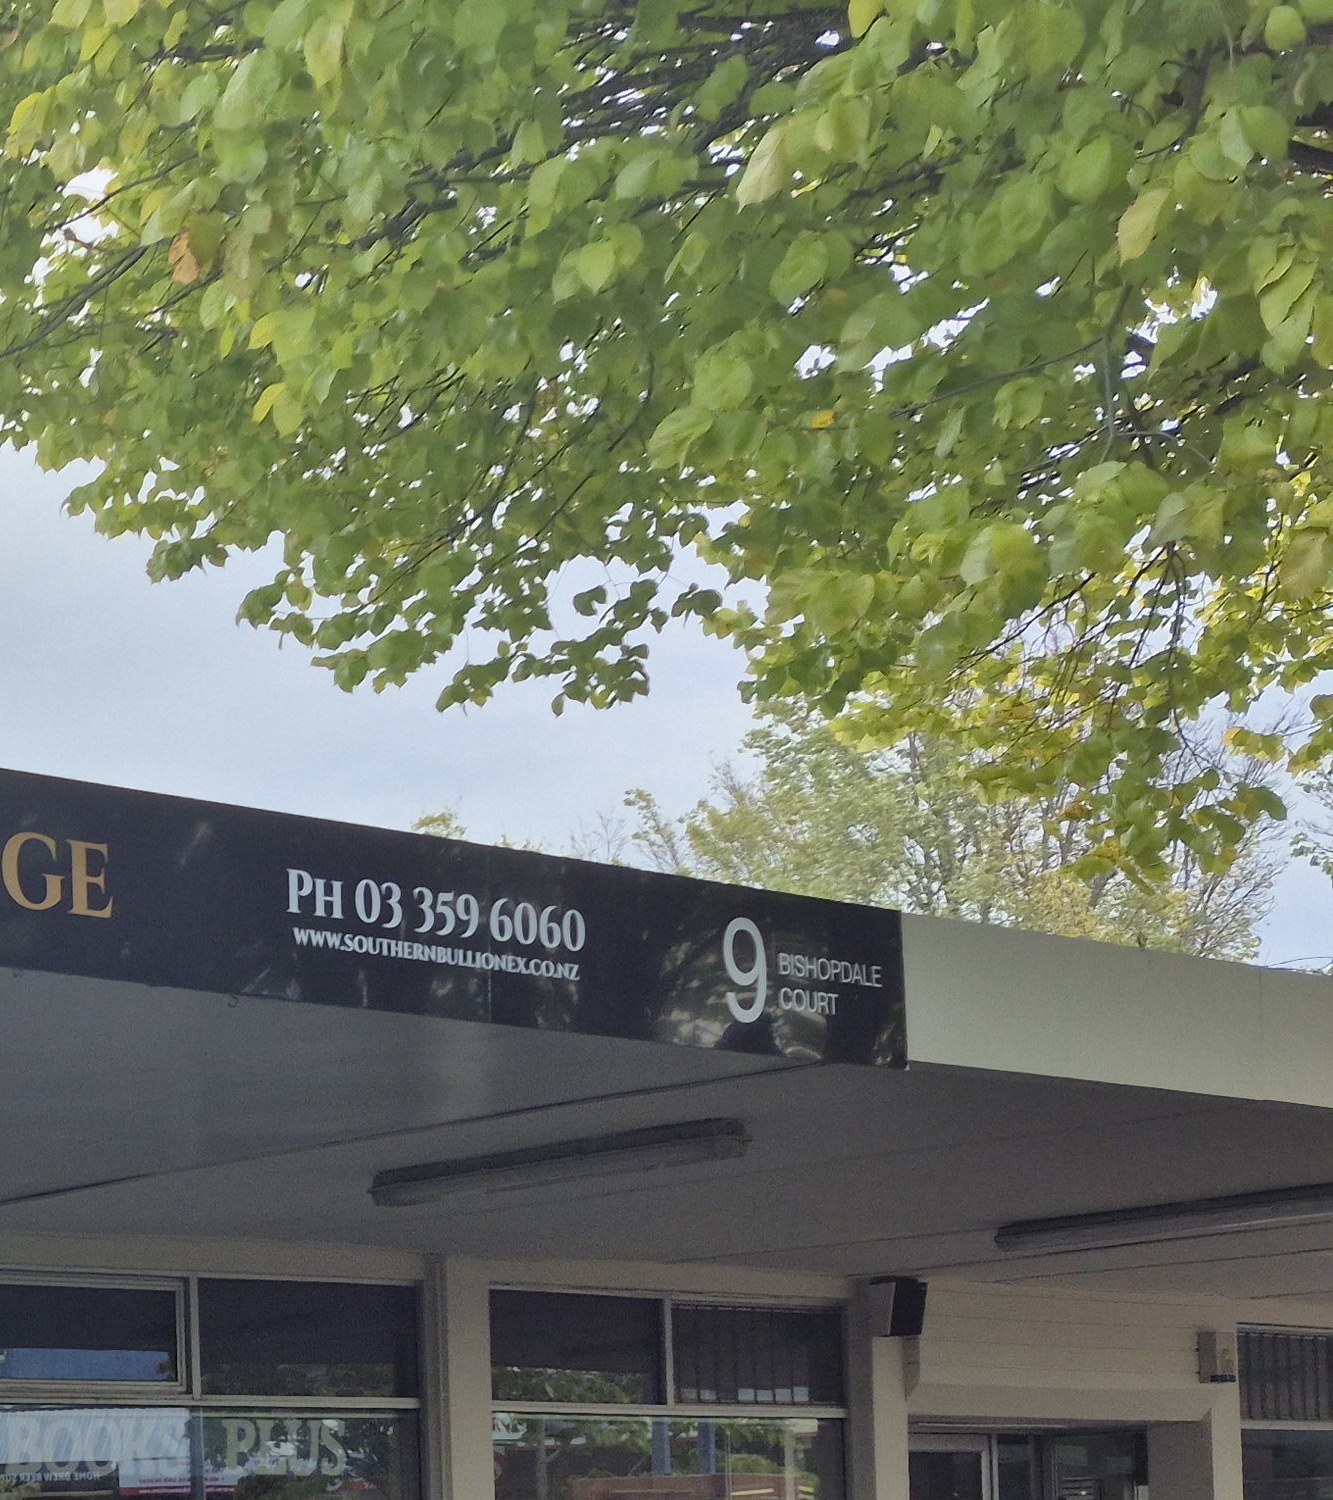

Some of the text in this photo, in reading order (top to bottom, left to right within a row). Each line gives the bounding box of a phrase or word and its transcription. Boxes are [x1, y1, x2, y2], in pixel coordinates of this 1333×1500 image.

[285, 868, 585, 952] PH 03 359 6060
[293, 926, 580, 981] WWW.SOUTHERNBULLIONEX.CO.NZ
[723, 916, 768, 1024] 9
[778, 951, 882, 989] BISHOPDALE
[779, 987, 839, 1016] COURT
[7, 1418, 186, 1476] BOOKS
